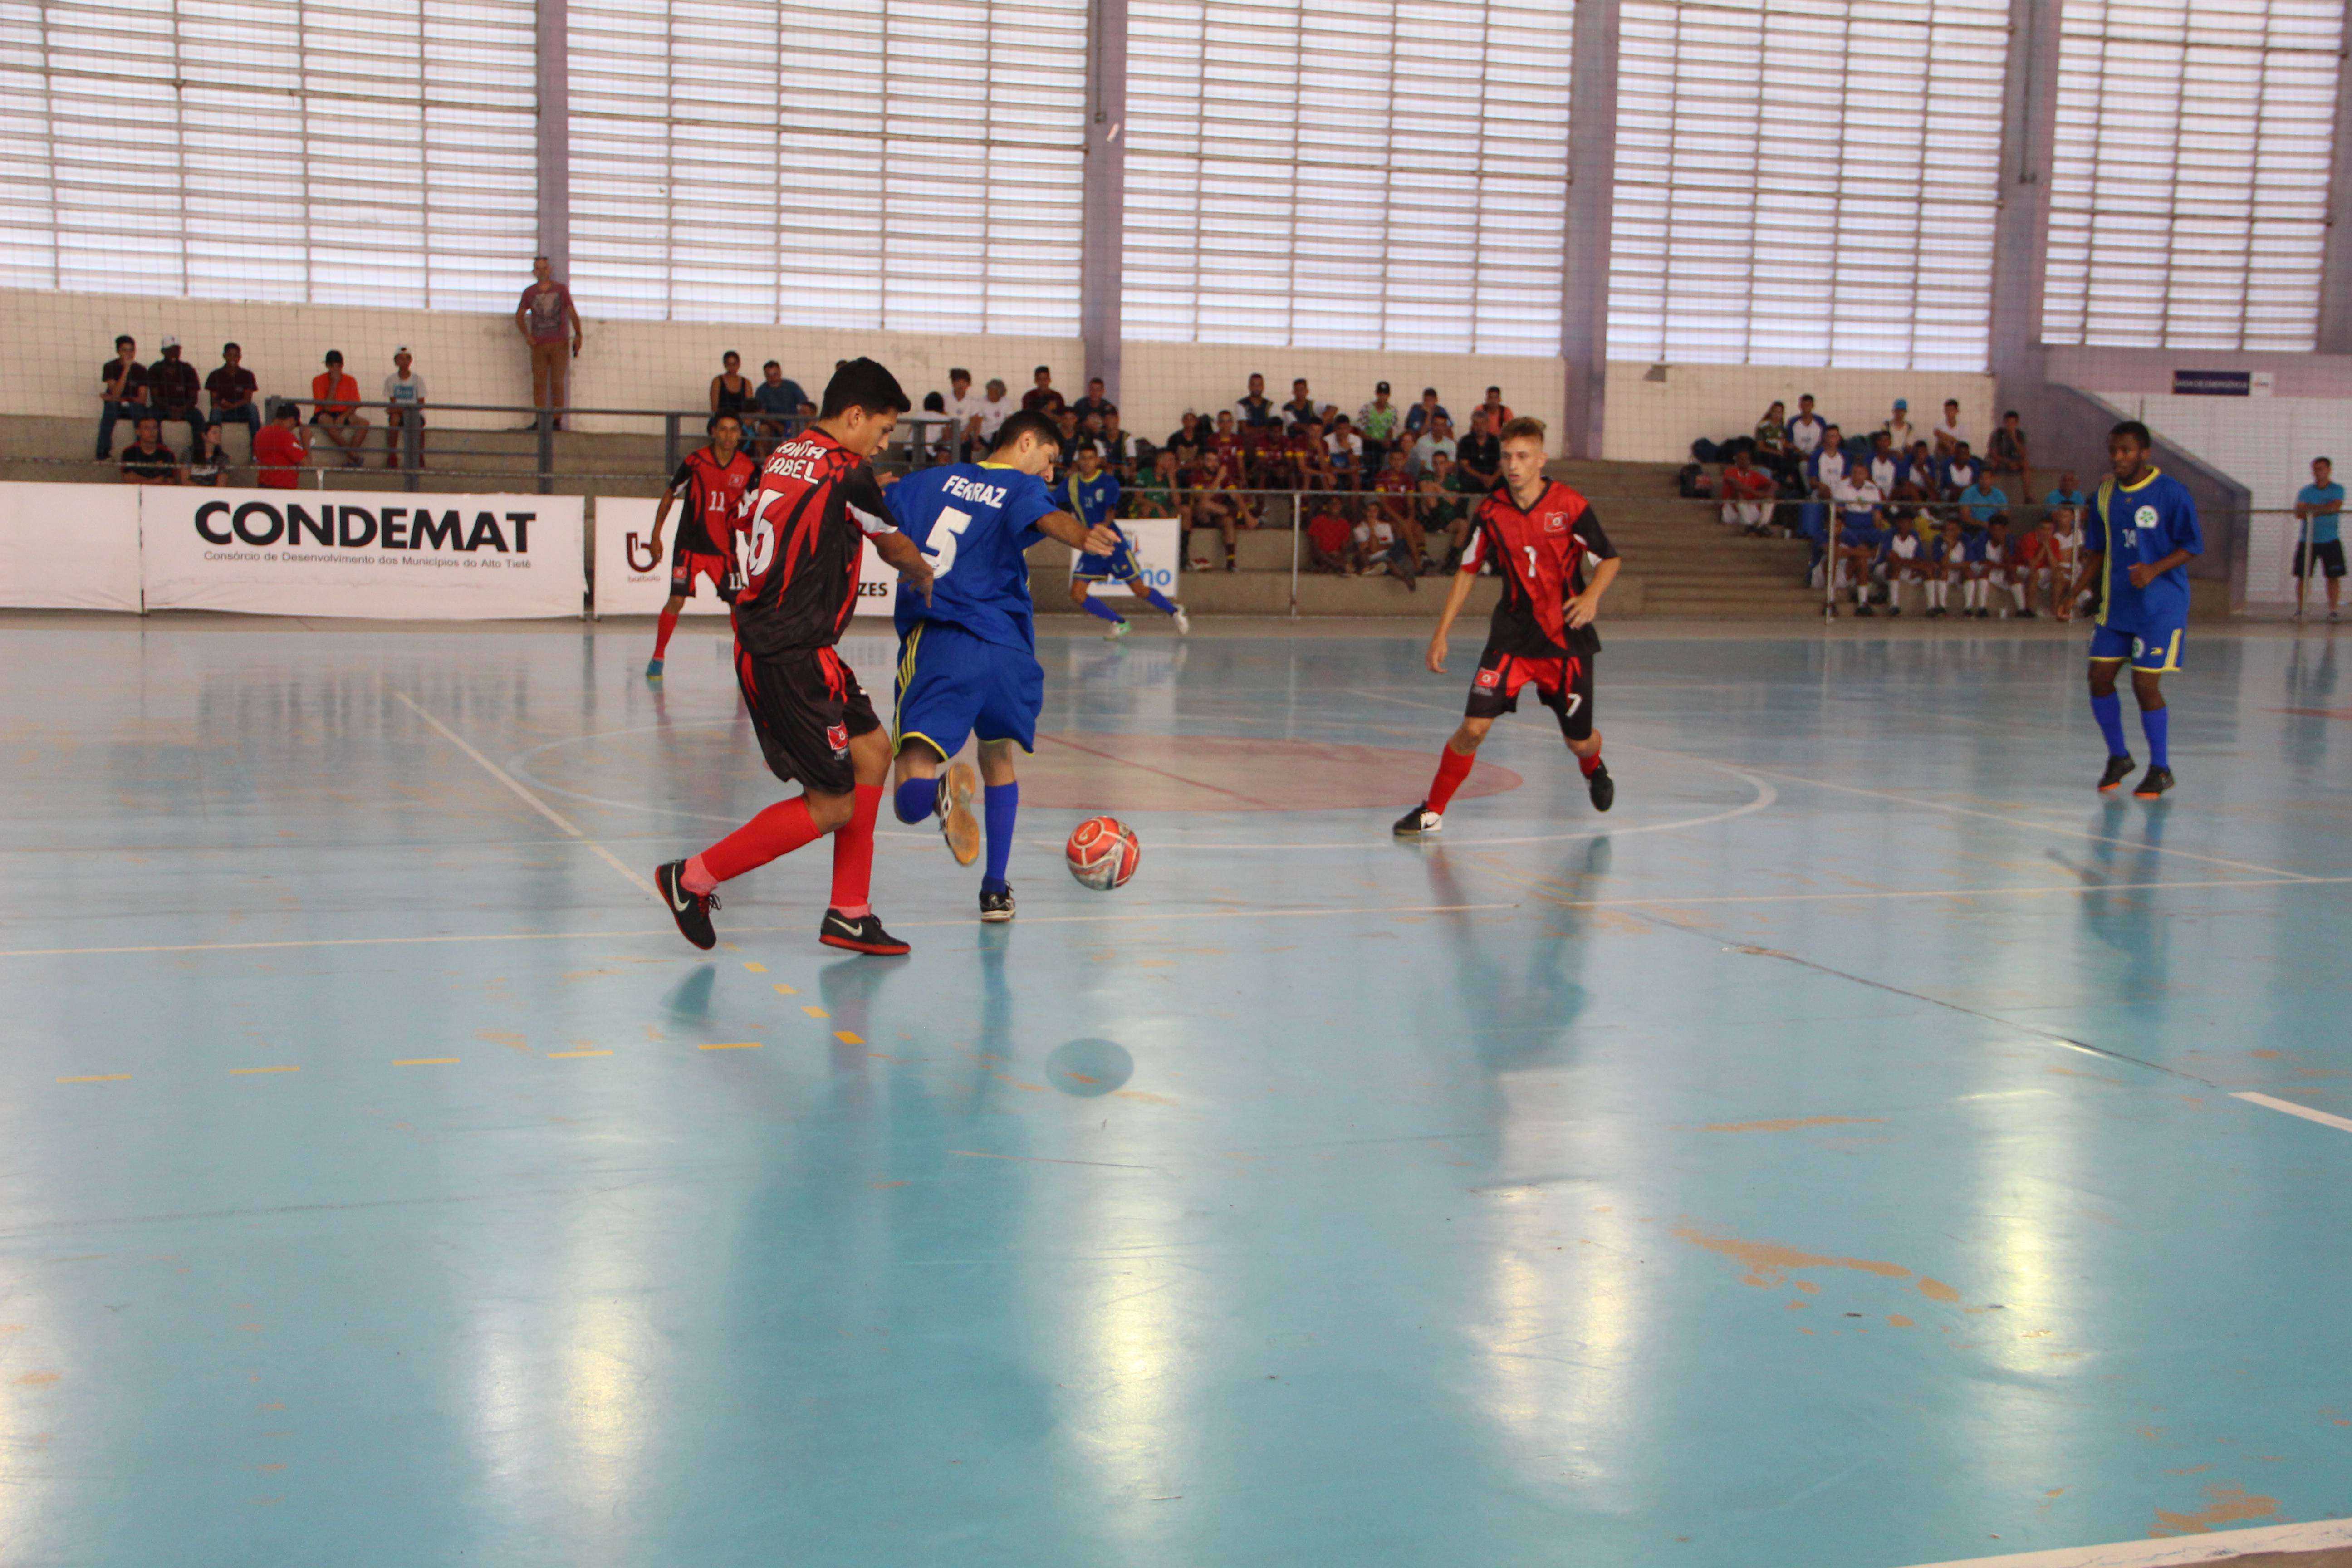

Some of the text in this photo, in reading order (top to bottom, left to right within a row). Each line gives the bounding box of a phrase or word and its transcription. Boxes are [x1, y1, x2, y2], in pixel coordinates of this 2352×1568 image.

[774, 440, 828, 460] ANTA
[709, 490, 725, 511] 11
[941, 475, 1007, 508] FERRAZ
[195, 500, 536, 553] CONDEMAT
[921, 505, 972, 579] 5
[204, 550, 260, 561] Consórcio
[264, 552, 278, 561] de
[282, 552, 374, 564] Desenvolvimento
[379, 555, 397, 564] dos
[463, 558, 477, 567] do
[481, 558, 501, 568] Alto
[729, 573, 742, 590] 11
[1566, 693, 1582, 717] 7
